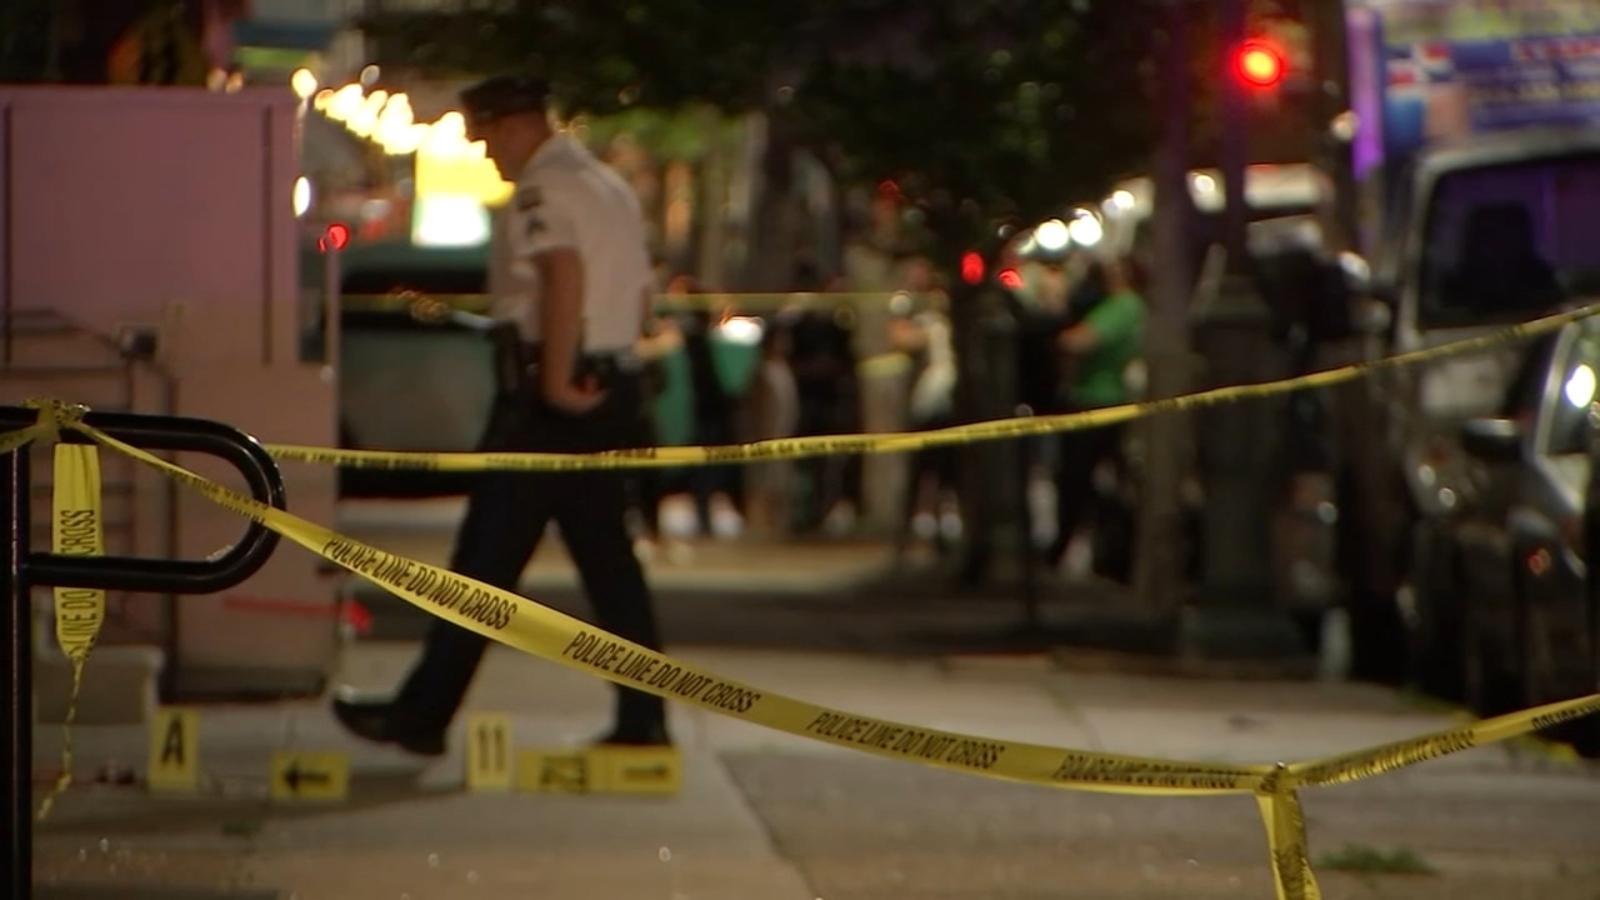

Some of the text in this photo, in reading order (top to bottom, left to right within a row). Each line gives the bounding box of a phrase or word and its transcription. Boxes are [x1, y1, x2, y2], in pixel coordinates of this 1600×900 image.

[60, 510, 96, 556] CROSS
[61, 589, 97, 609] DO
[322, 539, 517, 630] POLICE LINE DO NOT CROSS
[562, 631, 761, 713] POLICE LINE DO NOT CROSS
[160, 715, 187, 768] A
[477, 724, 506, 772] 11
[806, 711, 1005, 769] POLICE LINE DO NOT CROSS
